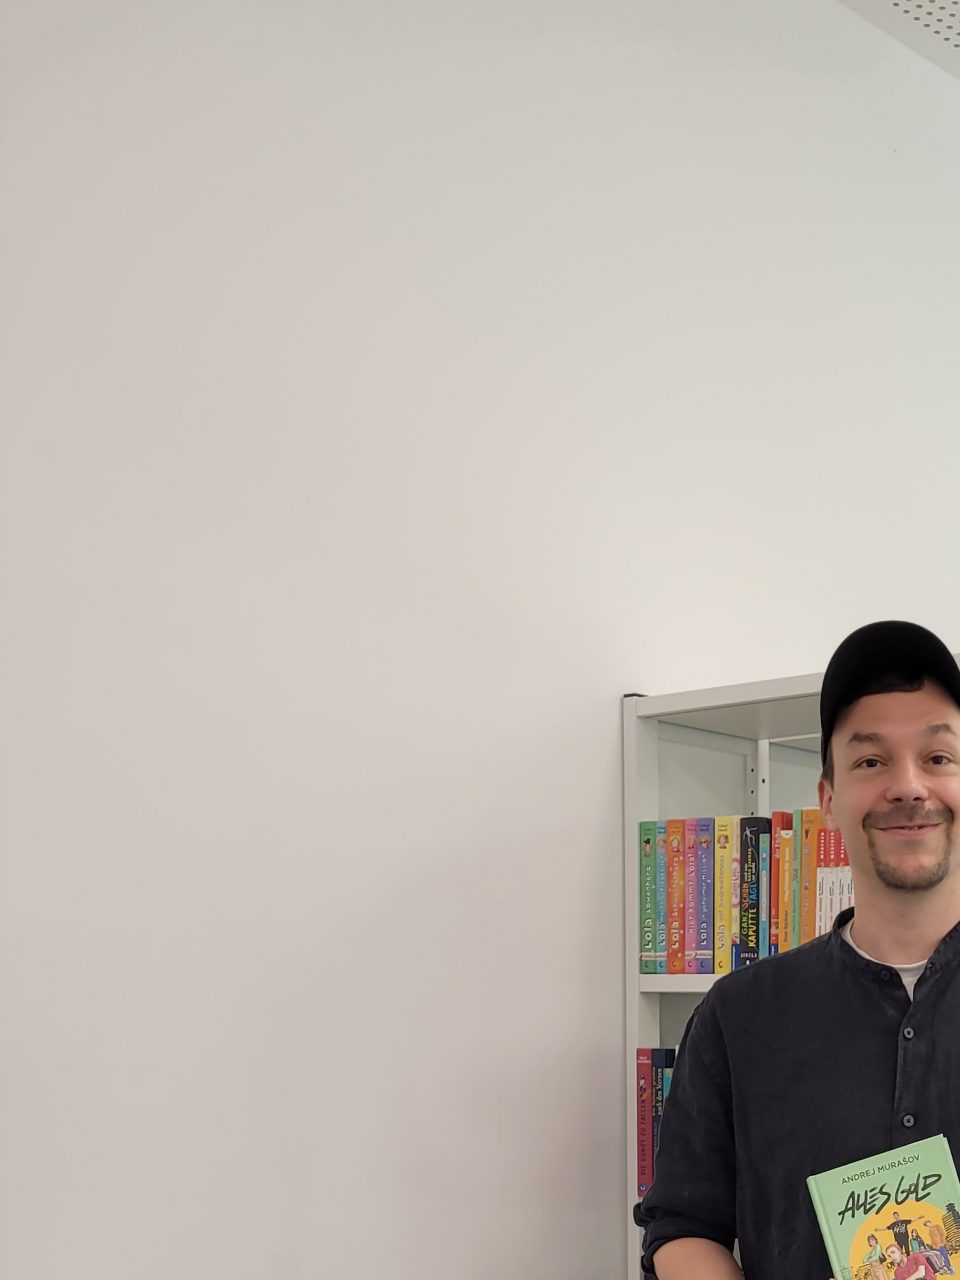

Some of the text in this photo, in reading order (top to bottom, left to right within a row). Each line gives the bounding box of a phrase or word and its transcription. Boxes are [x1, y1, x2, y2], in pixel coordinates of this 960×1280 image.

[644, 917, 652, 948] Lola
[671, 921, 679, 948] Lola
[749, 908, 757, 947] KAPUTTE
[841, 1153, 920, 1185] ANDREJ MURAŠOV
[838, 1172, 943, 1226] ALLES GOLD
